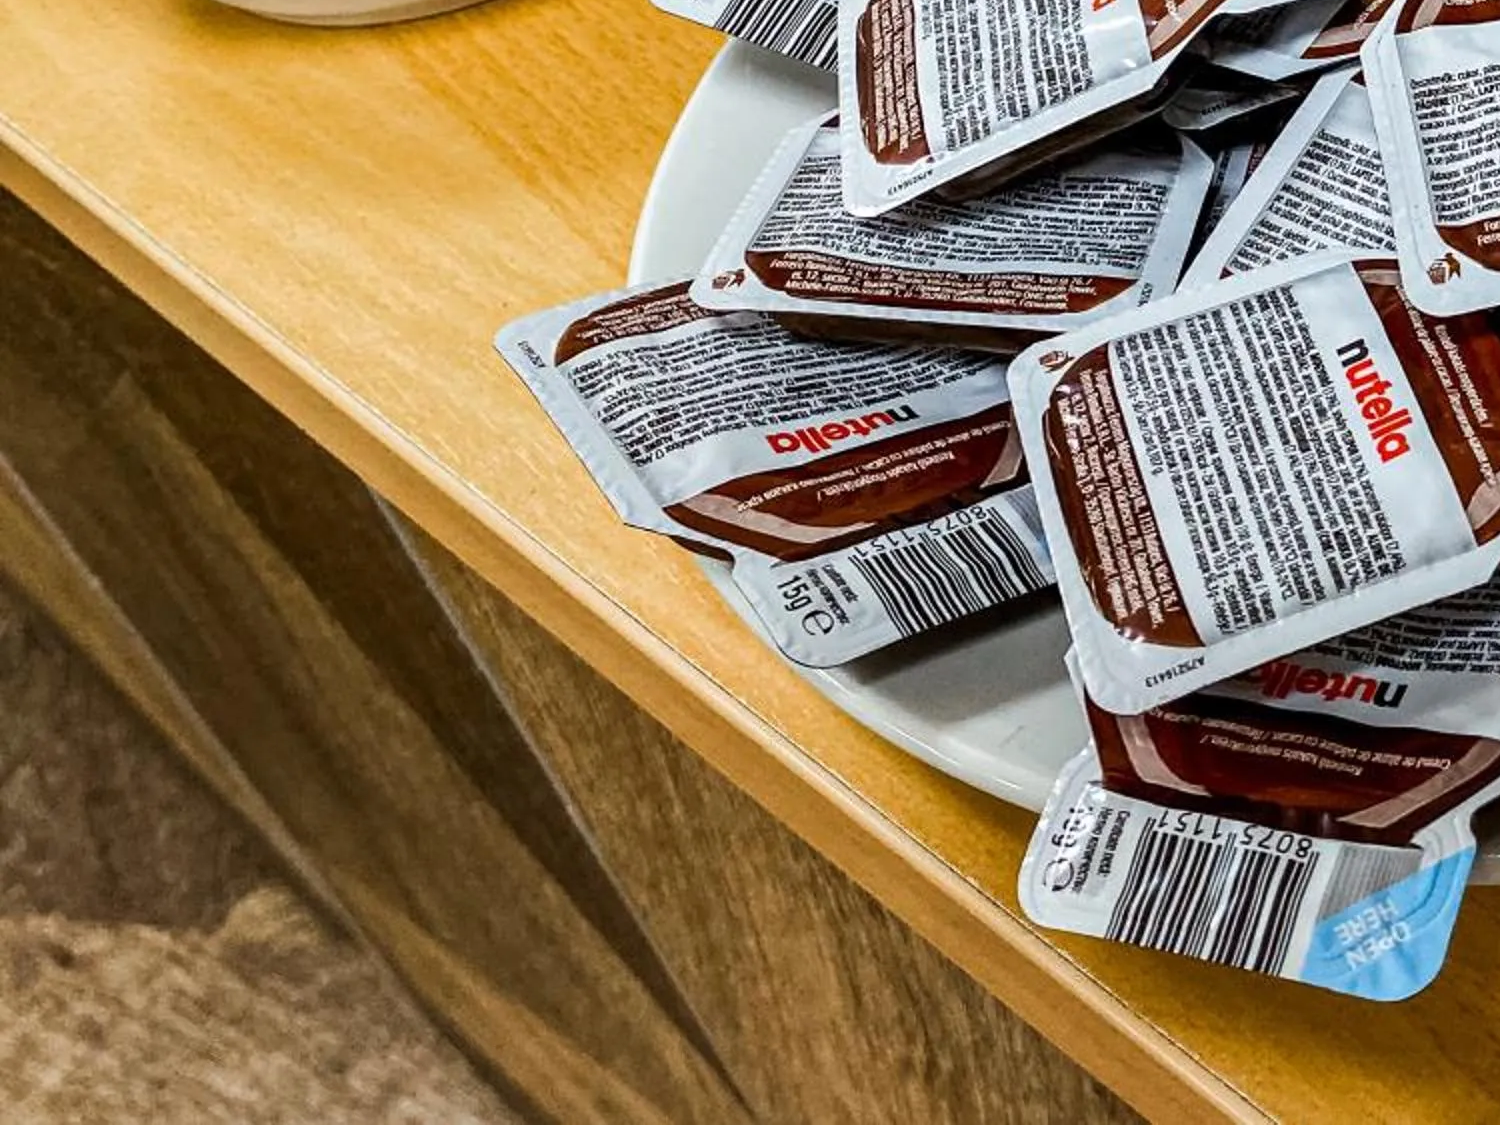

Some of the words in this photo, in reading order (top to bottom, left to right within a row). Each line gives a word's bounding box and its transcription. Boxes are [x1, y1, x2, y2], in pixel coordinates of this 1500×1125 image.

[1335, 337, 1414, 464] nutella
[765, 404, 921, 455] nutella
[777, 574, 812, 613] 15g
[1258, 661, 1409, 709] nutell
[1155, 809, 1223, 840] 1151
[1239, 823, 1314, 859] 8075
[1333, 898, 1401, 944] HERE
